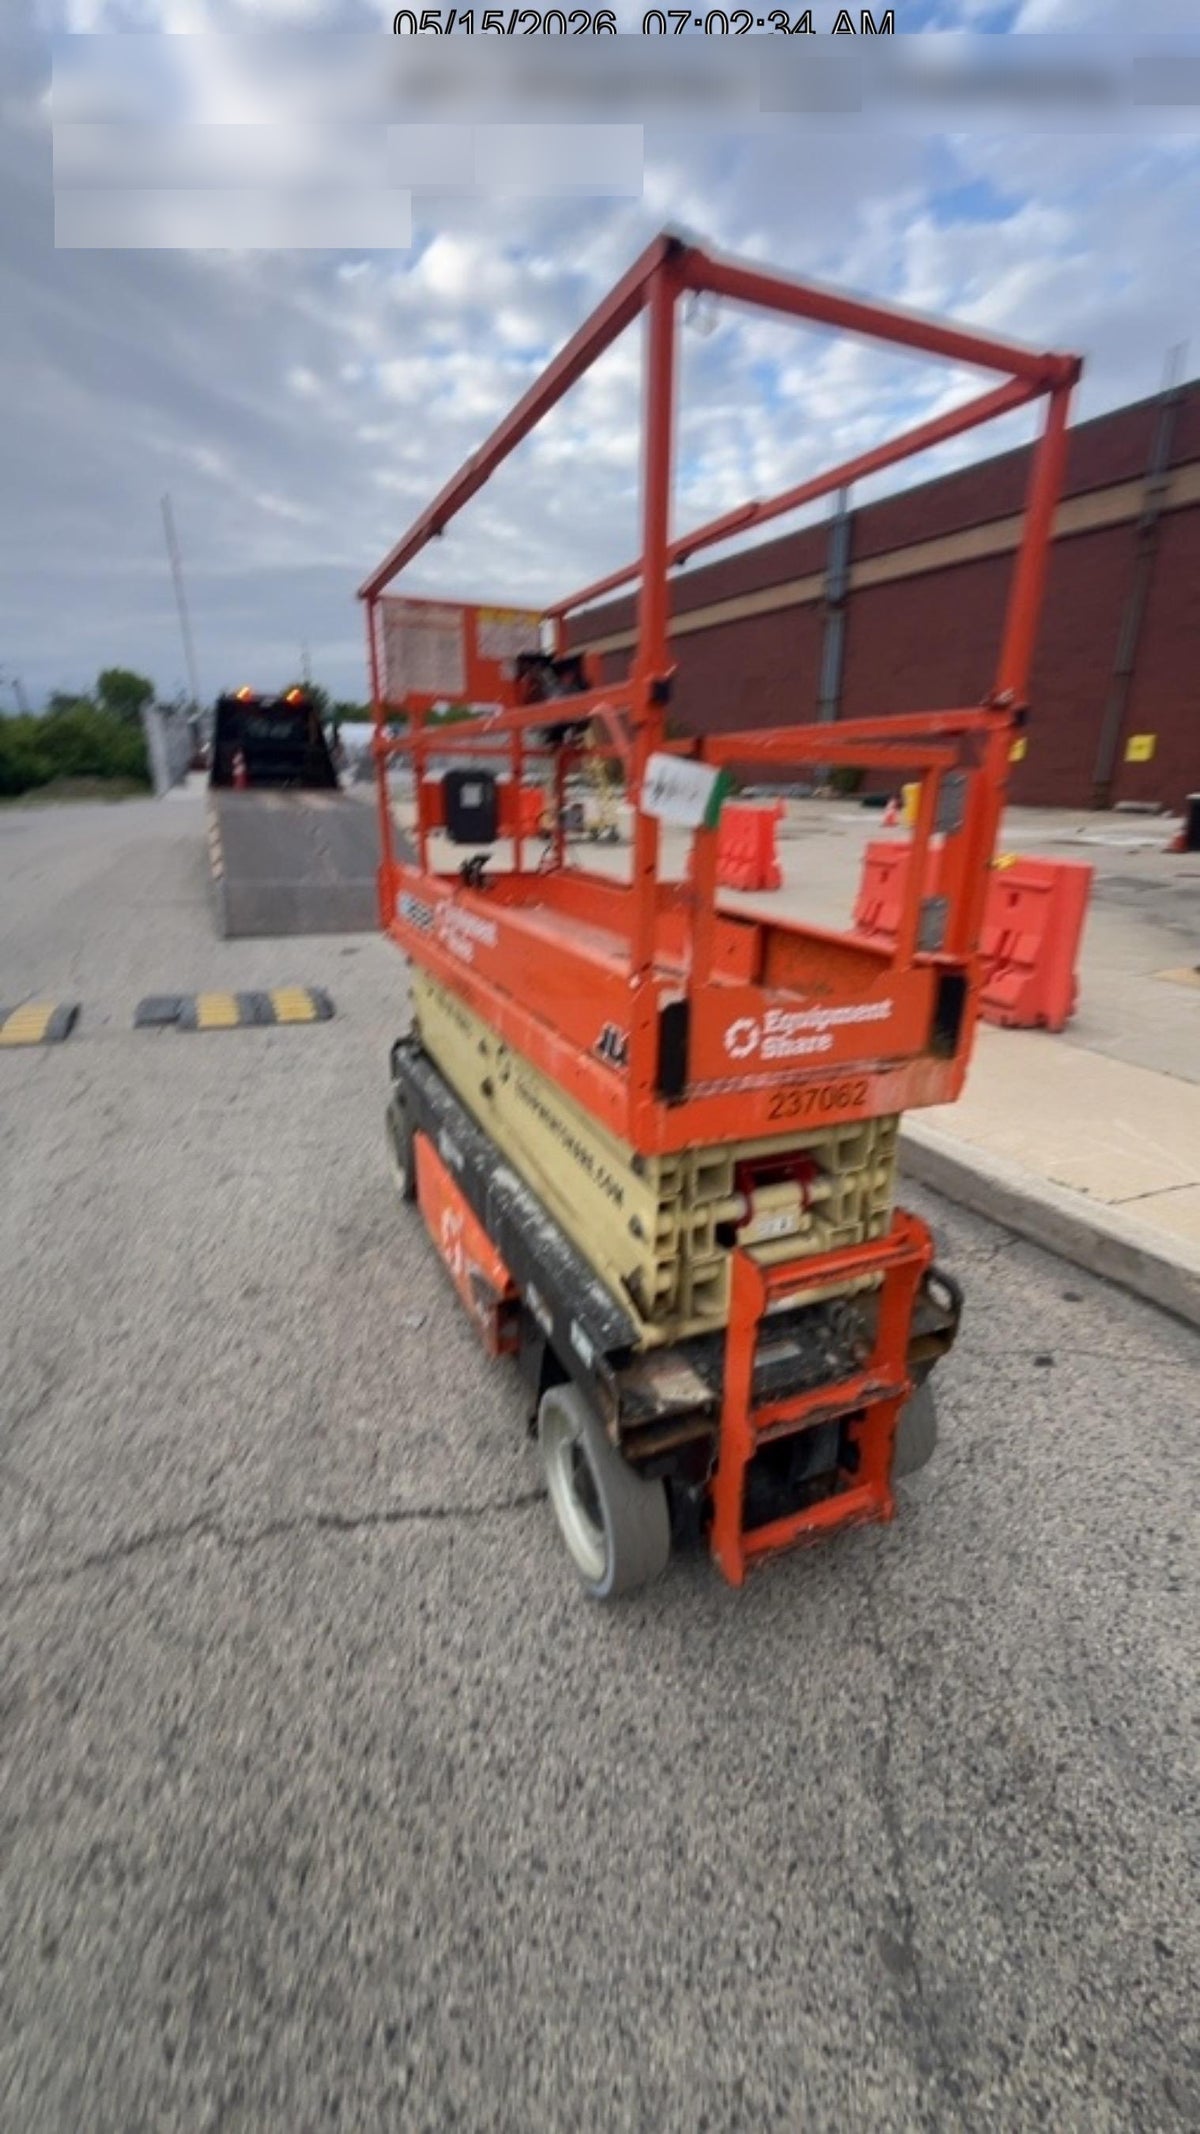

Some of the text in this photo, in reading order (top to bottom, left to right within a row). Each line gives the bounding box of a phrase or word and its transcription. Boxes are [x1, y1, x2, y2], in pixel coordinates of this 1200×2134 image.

[762, 998, 894, 1034] Equipment
[760, 1032, 834, 1060] Share
[767, 1080, 869, 1121] 237062
